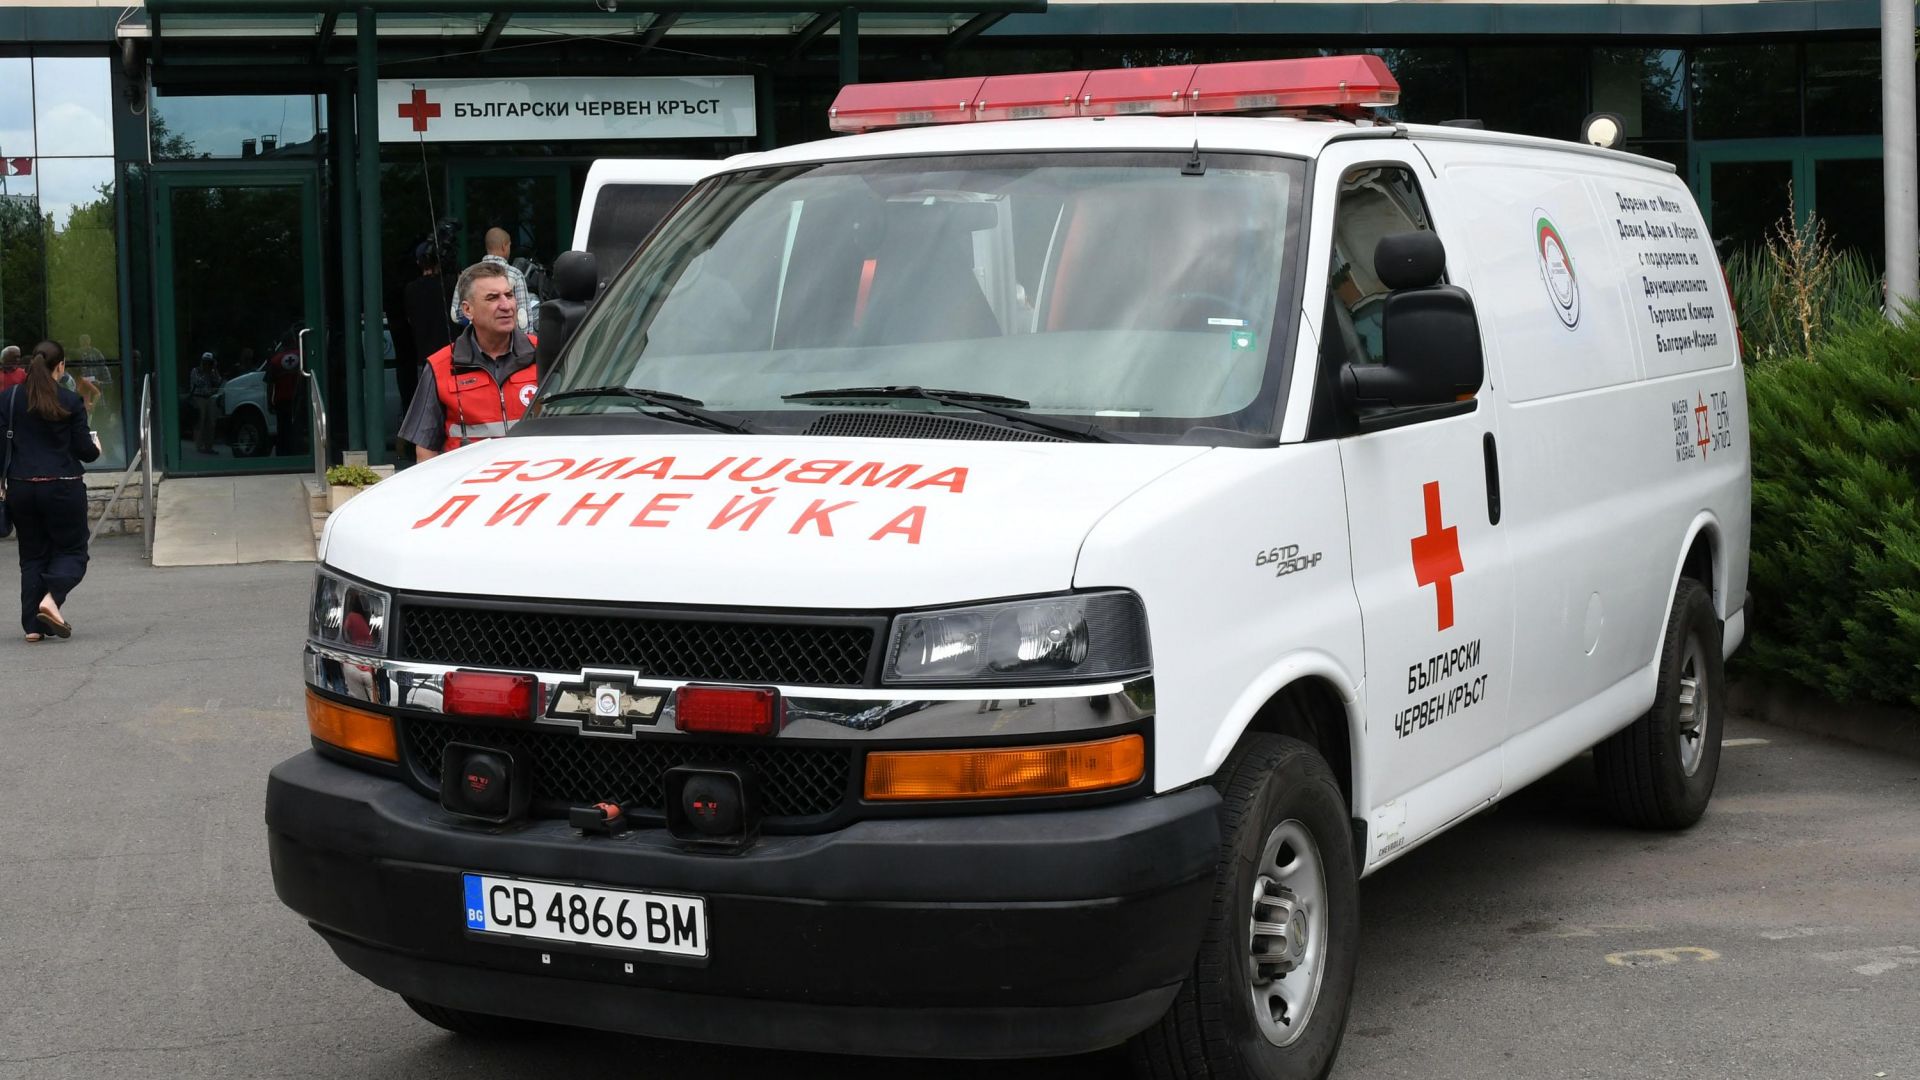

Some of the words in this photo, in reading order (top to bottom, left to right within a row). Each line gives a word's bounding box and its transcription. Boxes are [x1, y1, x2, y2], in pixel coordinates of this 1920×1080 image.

[454, 102, 569, 118] БЪЛГАРСКИ
[576, 101, 652, 116] ЧЕРВЕН
[657, 100, 720, 115] КРЪСТ
[1616, 192, 1649, 216] Дарени
[1648, 202, 1657, 212] от
[1645, 220, 1666, 239] Адом
[1672, 221, 1699, 243] Израел
[1638, 252, 1644, 265] с
[1645, 252, 1688, 270] подкрепата
[1690, 253, 1699, 266] на
[1643, 276, 1708, 298] Двунационалната
[1648, 304, 1687, 328] Търговска
[1687, 302, 1715, 325] Камара
[413, 487, 927, 545] ЛИНЕЙКА
[1256, 544, 1299, 566] 6.6TD
[1276, 552, 1322, 577] 250HP
[1407, 638, 1481, 694] БЪЛГАРСКИ
[1395, 691, 1444, 739] ЧЕРВЕН
[1446, 674, 1488, 718] КРЪСТ
[468, 908, 484, 922] BG
[490, 885, 537, 929] CB
[546, 892, 637, 940] 4866
[646, 901, 698, 948] BM
